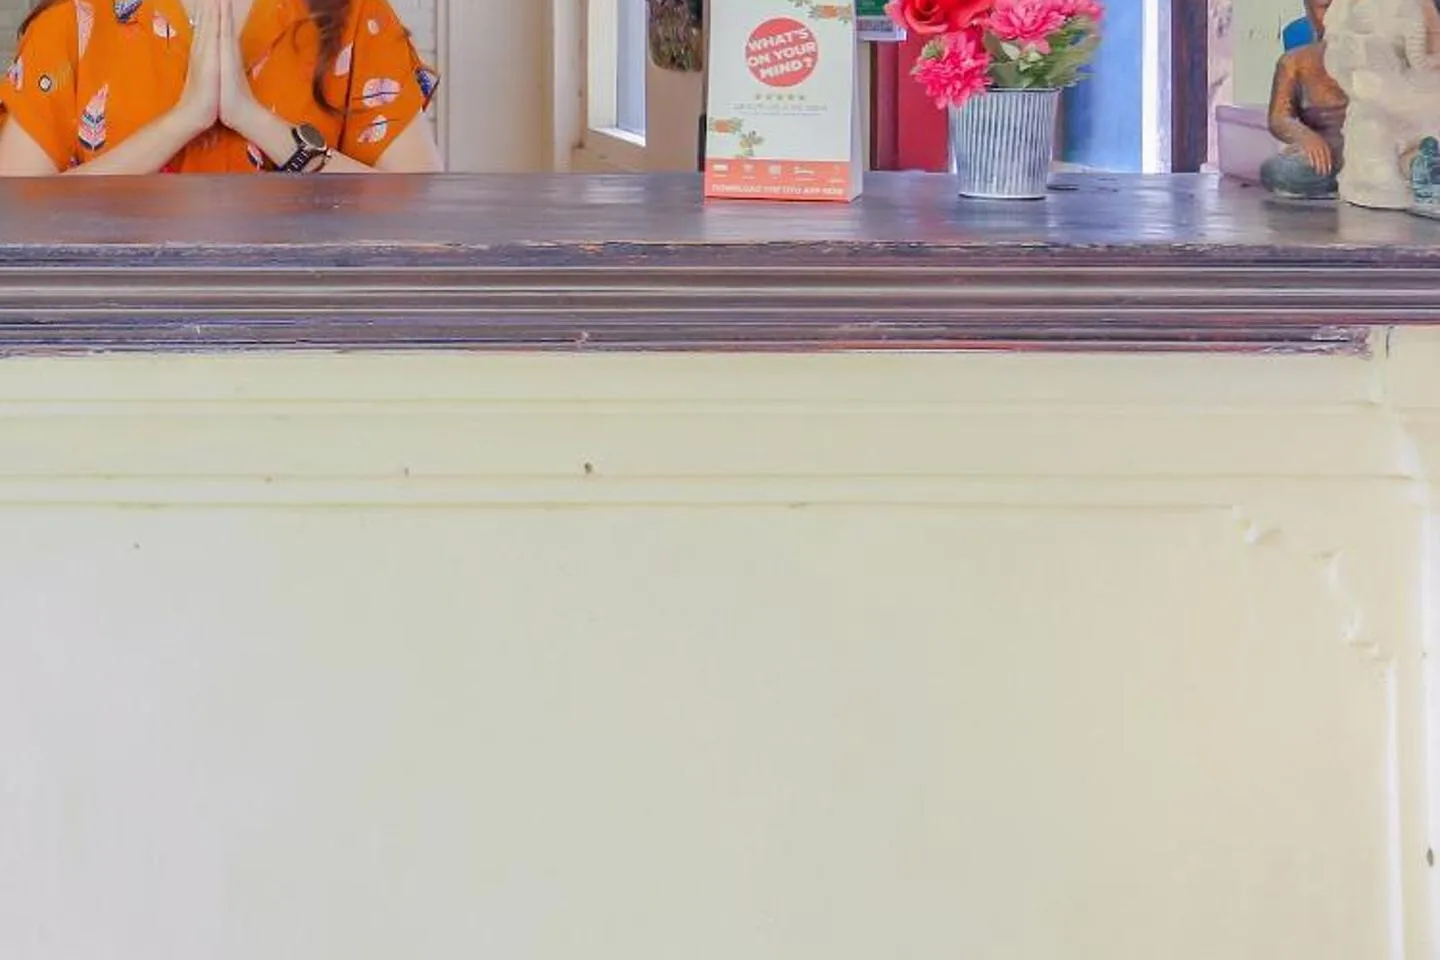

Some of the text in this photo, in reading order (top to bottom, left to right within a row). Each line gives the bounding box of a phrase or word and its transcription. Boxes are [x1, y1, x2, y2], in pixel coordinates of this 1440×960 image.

[748, 27, 809, 51] WHAT'S
[748, 41, 816, 67] ON YOUR
